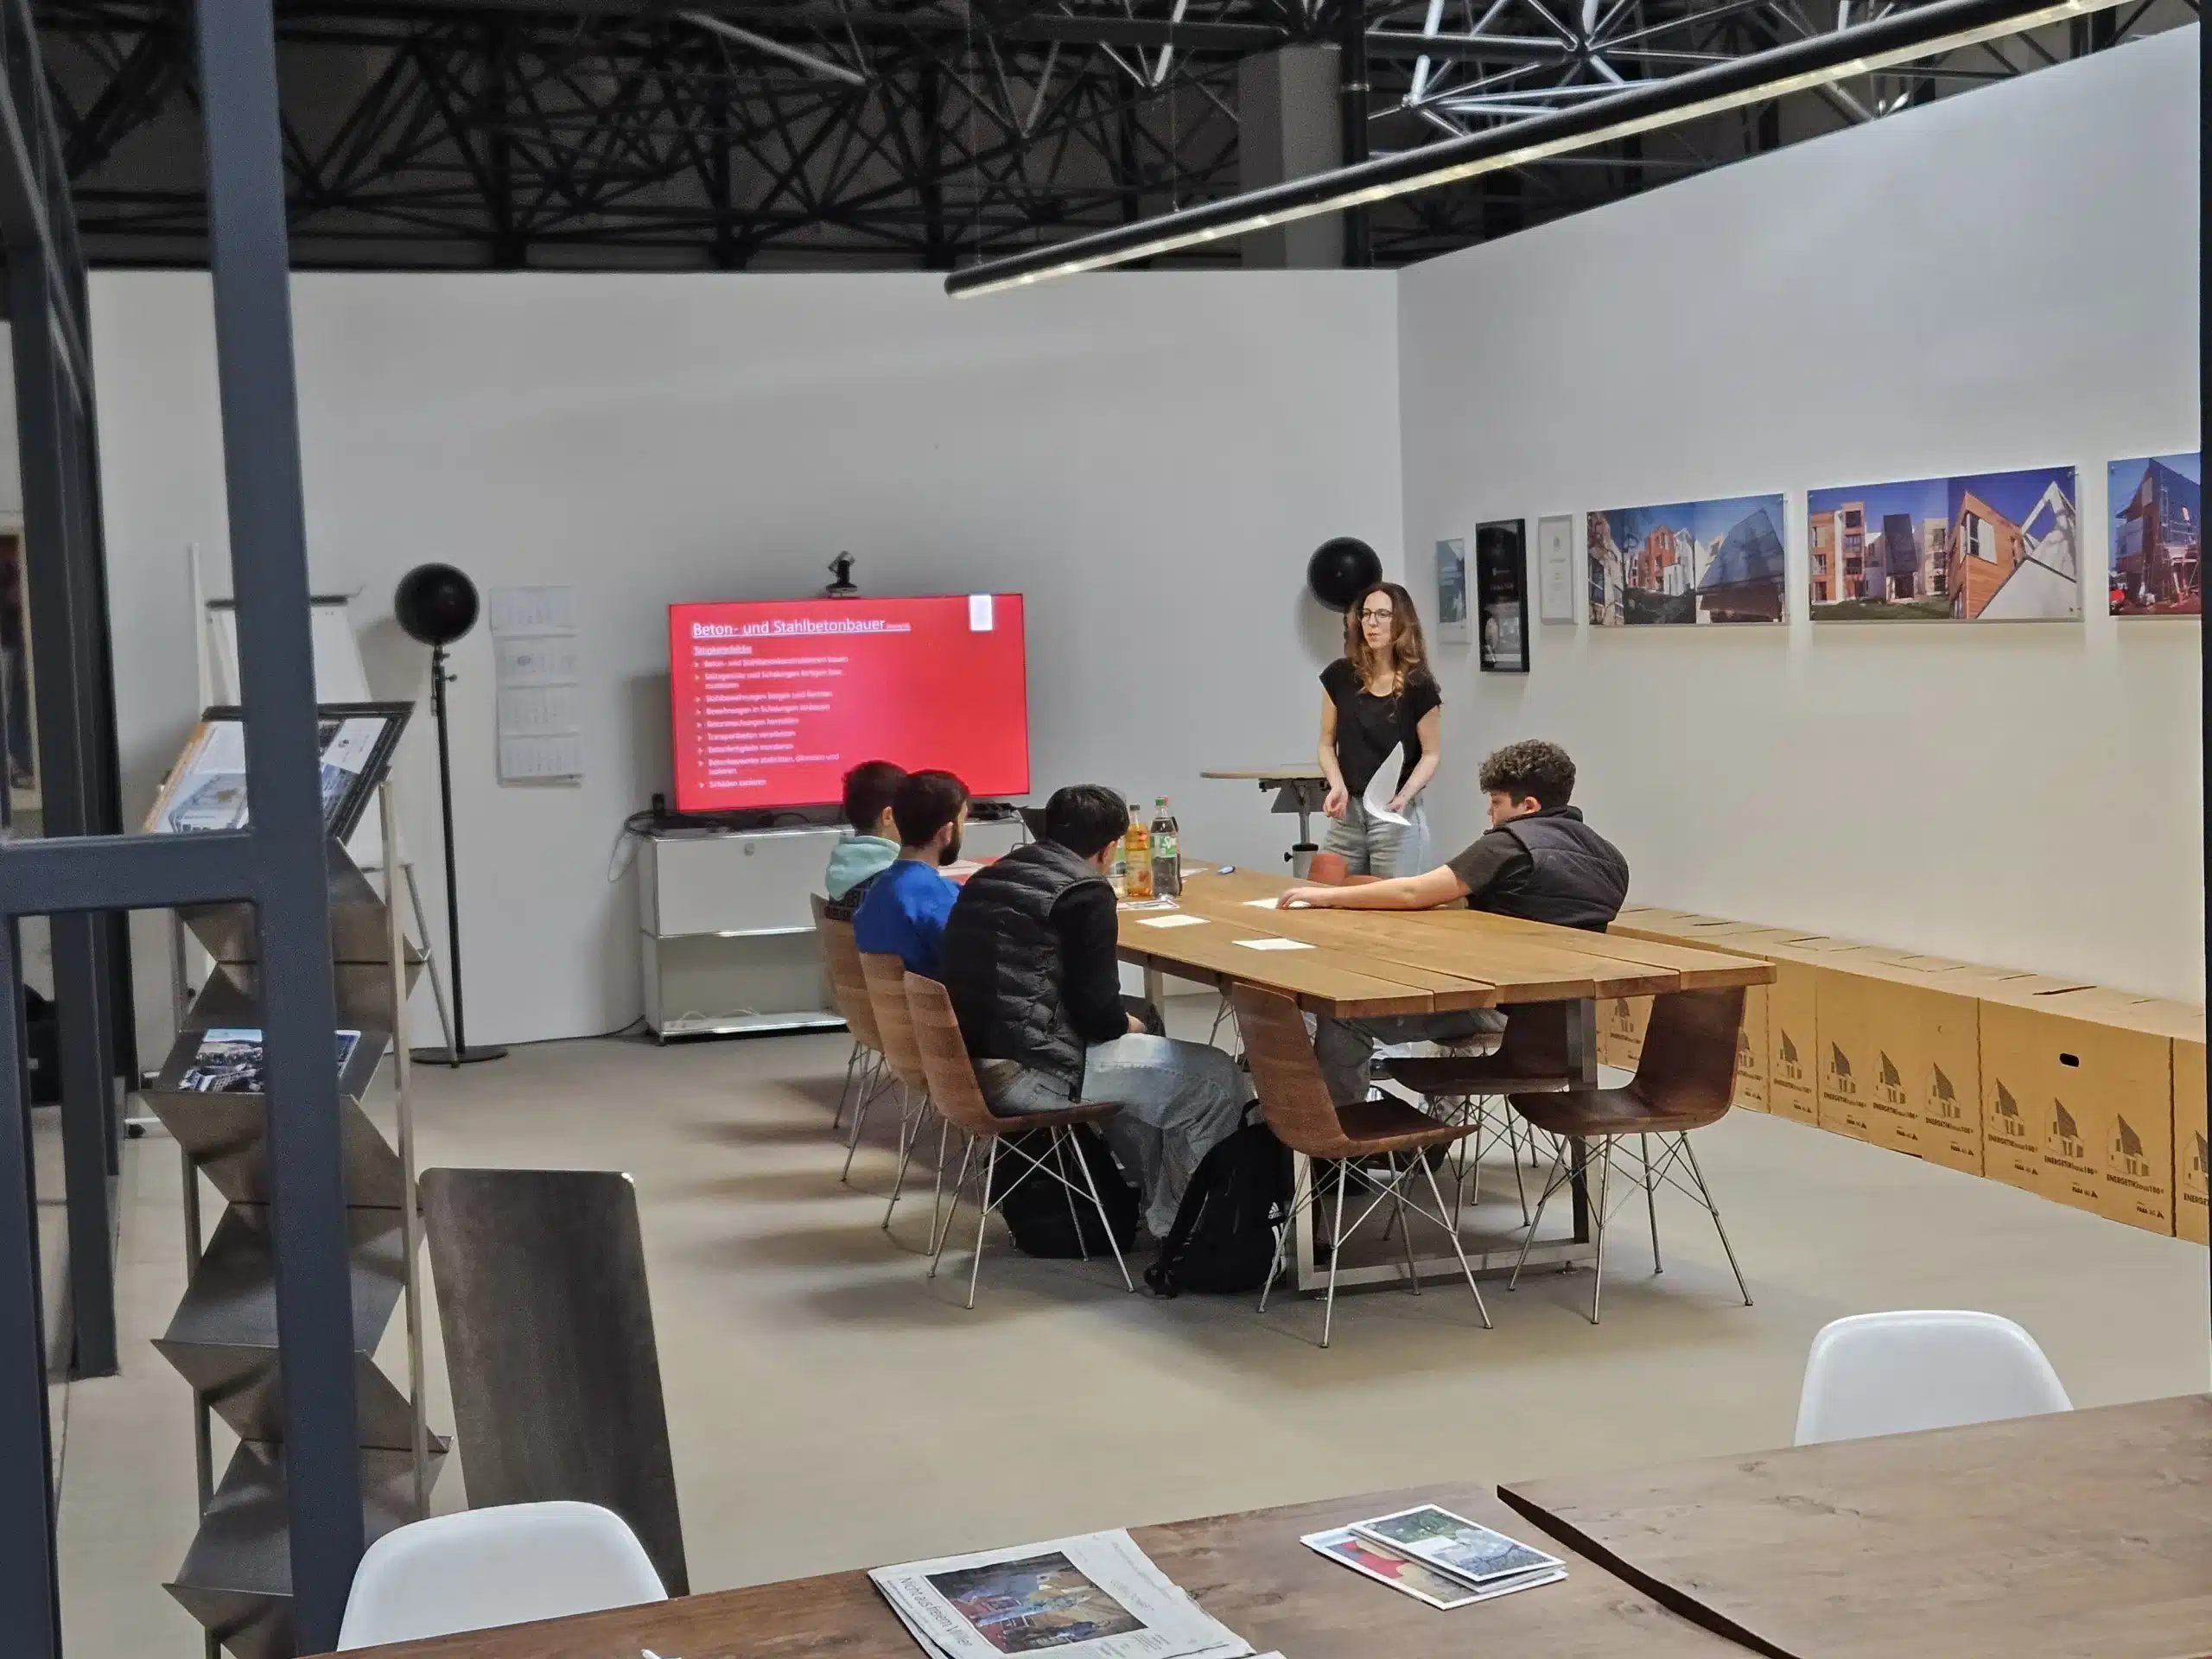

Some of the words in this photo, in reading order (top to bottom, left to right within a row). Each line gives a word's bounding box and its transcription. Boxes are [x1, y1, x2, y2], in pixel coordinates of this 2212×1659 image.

[693, 622, 739, 636] Beton-
[744, 621, 769, 634] und
[773, 617, 886, 633] Stahlbetonbauer
